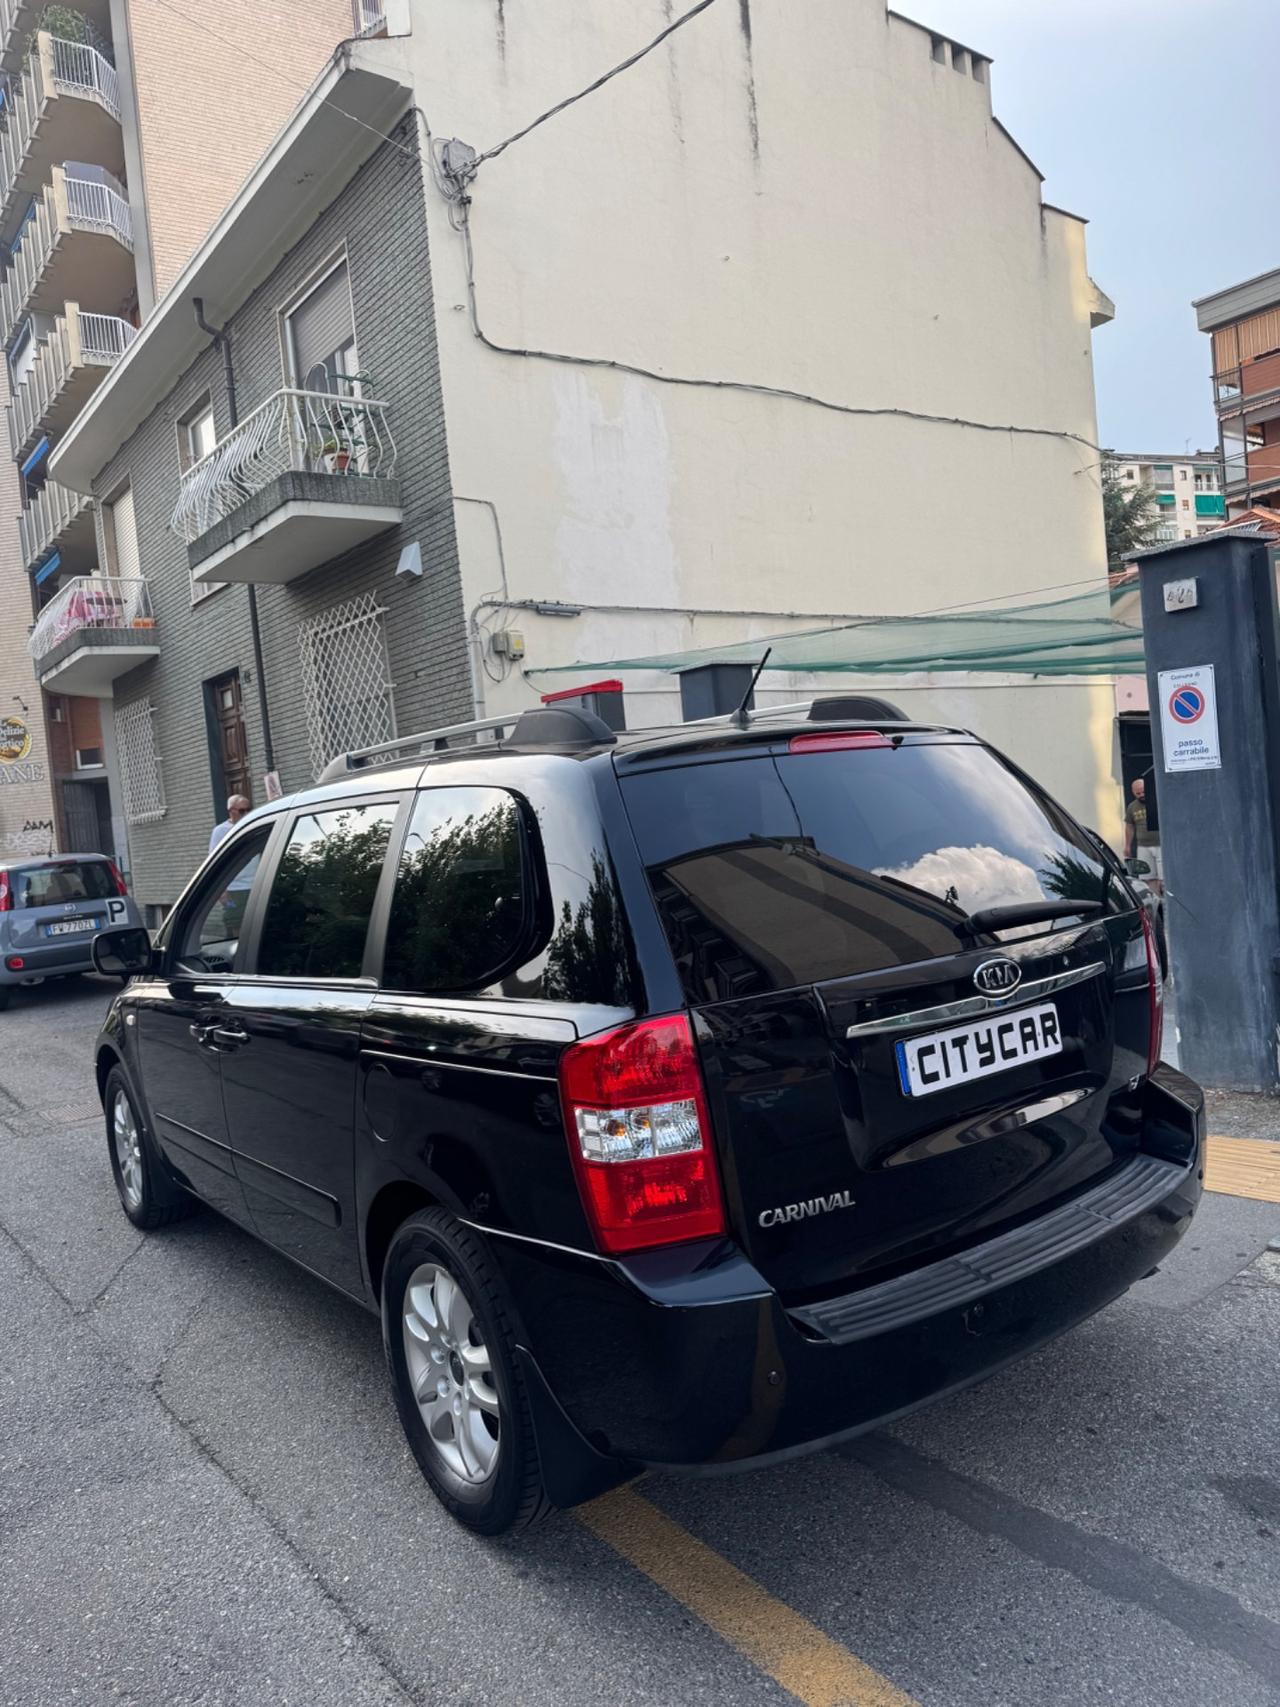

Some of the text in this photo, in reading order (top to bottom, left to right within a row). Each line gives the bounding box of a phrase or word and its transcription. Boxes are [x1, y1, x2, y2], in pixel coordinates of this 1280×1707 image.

[1172, 746, 1209, 757] carrabile
[1178, 739, 1203, 748] passo
[108, 901, 125, 923] P
[982, 963, 1015, 990] KIA
[916, 1011, 1060, 1086] CITYCAR
[758, 1190, 856, 1228] CARNIVAL
